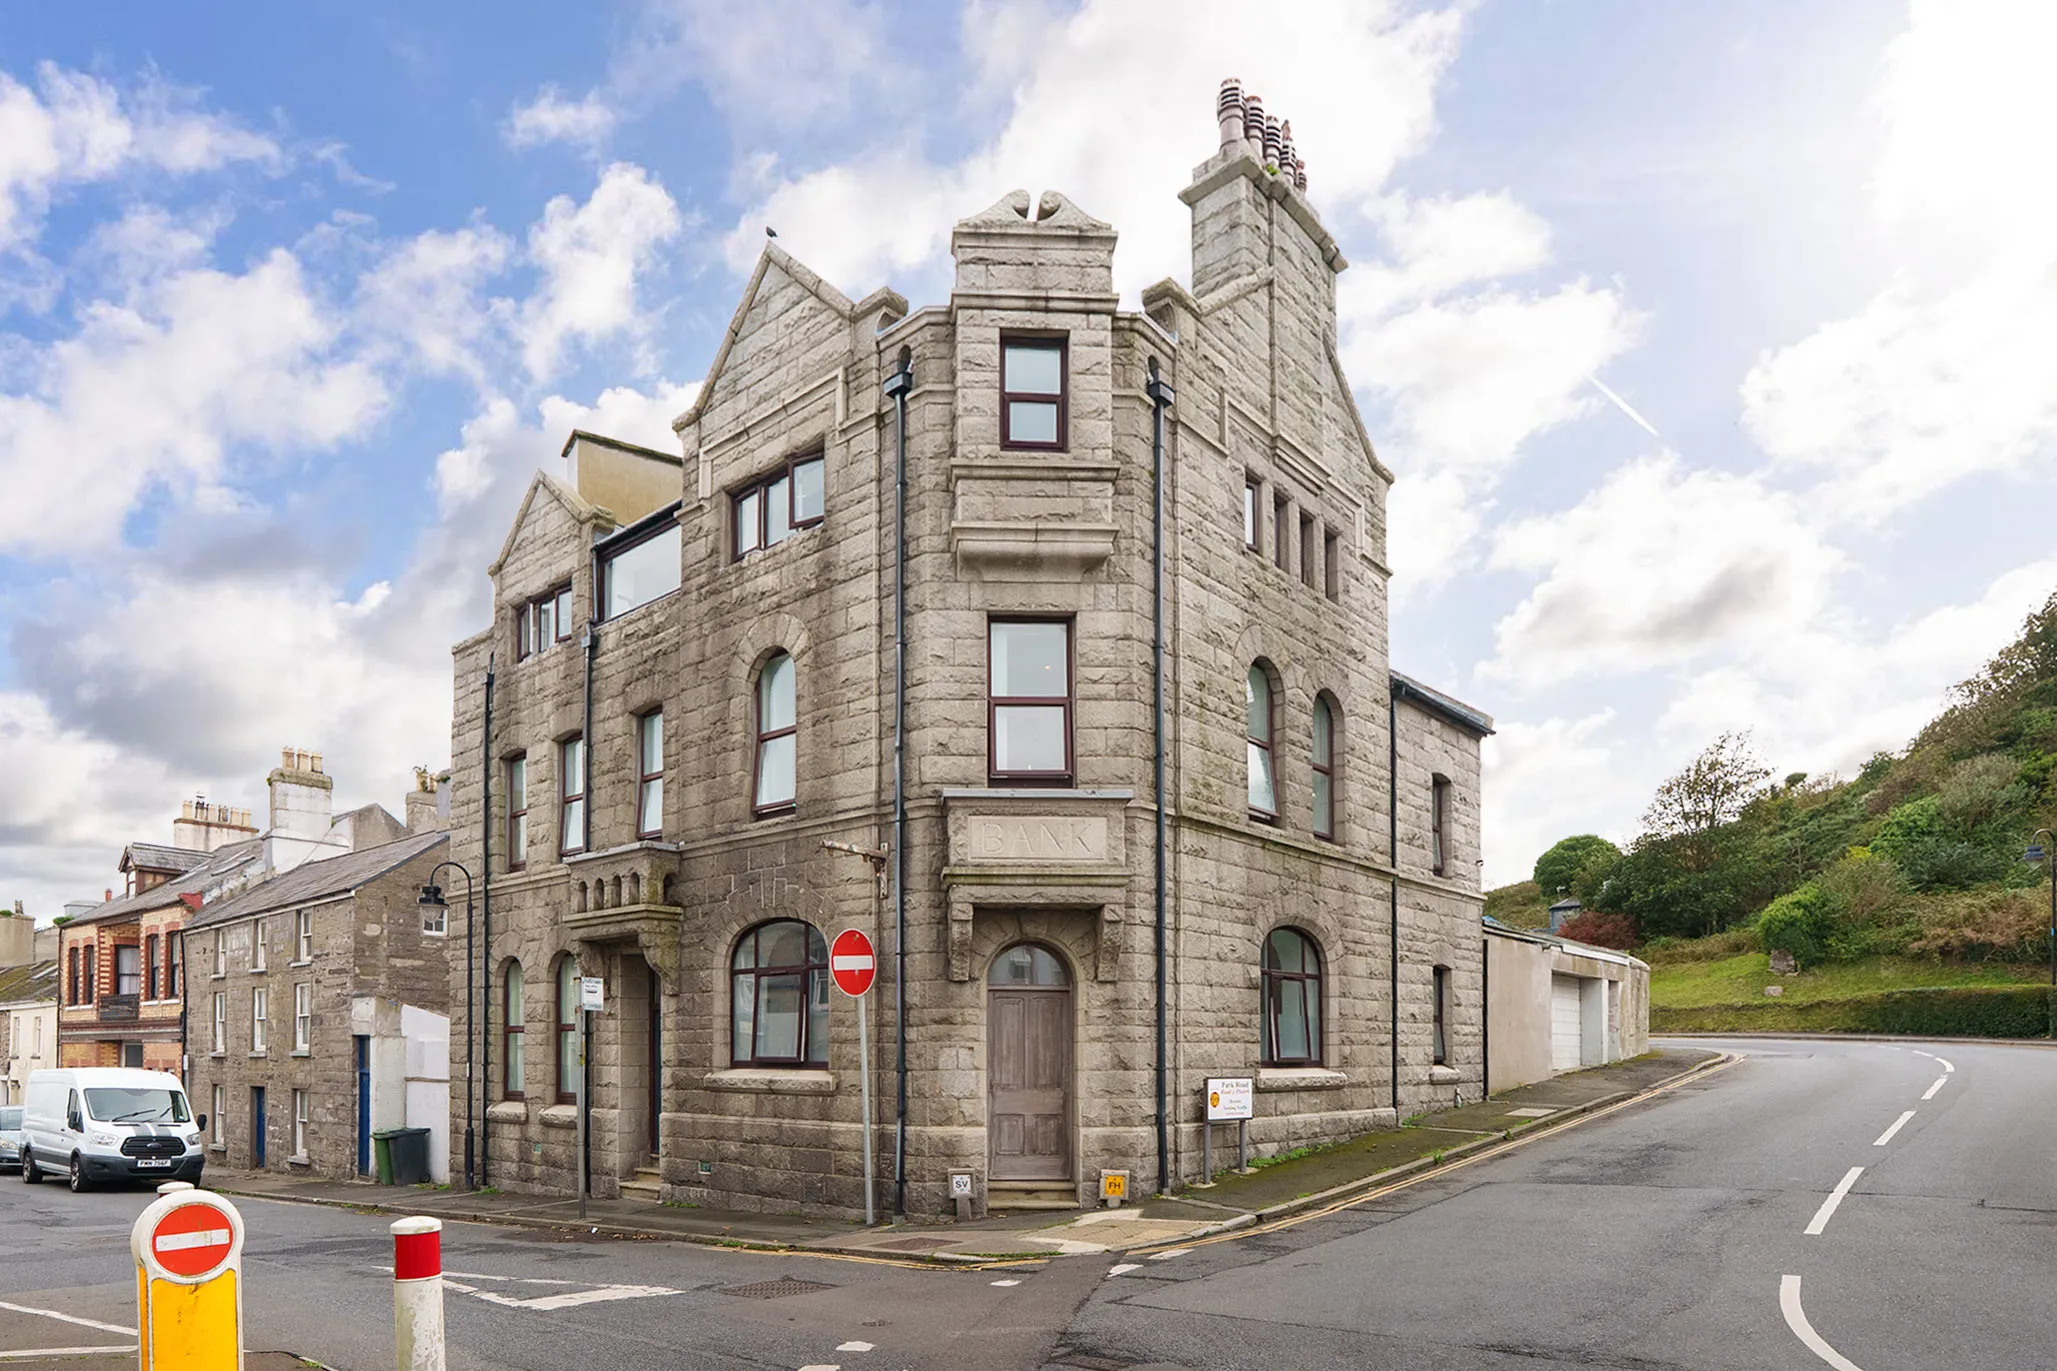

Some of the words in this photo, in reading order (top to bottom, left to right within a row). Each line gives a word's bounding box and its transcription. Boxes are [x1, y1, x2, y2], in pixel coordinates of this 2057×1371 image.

[980, 822, 1092, 853] BANK
[955, 1180, 968, 1188] SV
[1108, 1181, 1121, 1189] FH
